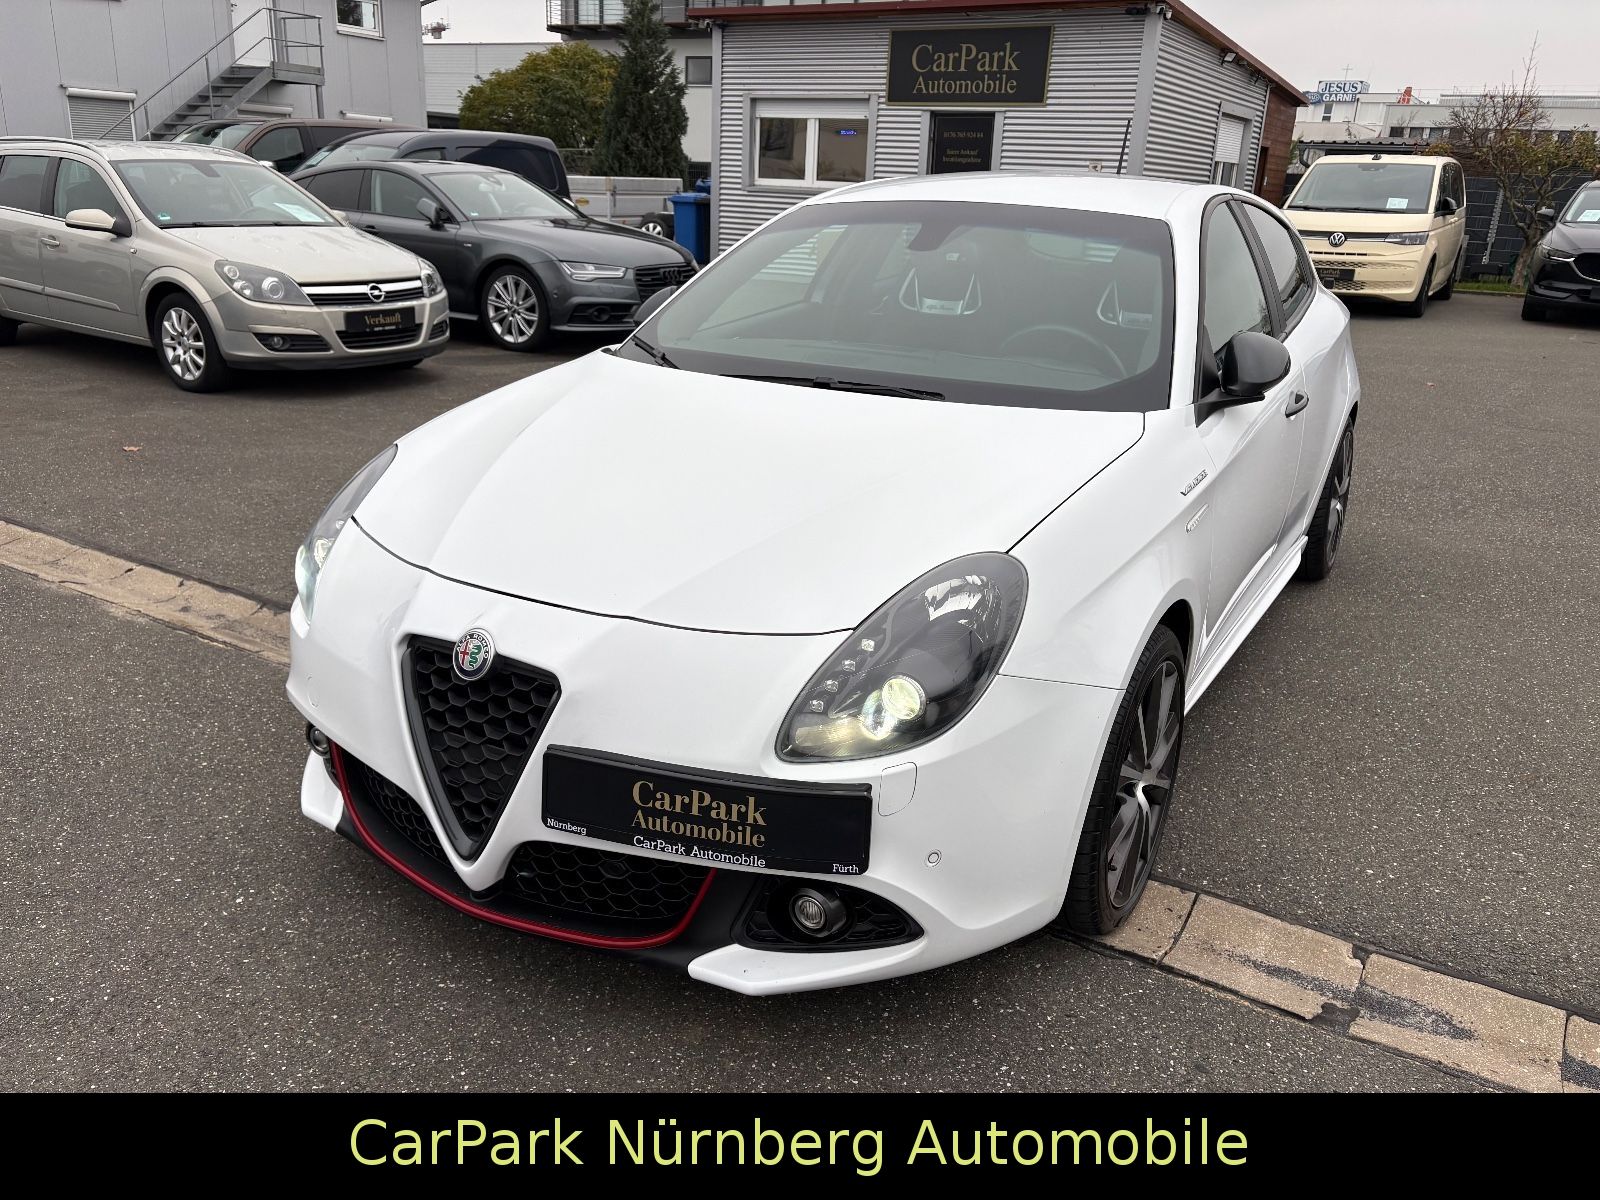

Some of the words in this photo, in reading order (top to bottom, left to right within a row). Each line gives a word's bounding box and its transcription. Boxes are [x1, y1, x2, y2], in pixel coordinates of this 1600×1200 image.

[912, 42, 1021, 73] CarPark
[912, 74, 1017, 94] Automobile
[1321, 82, 1359, 93] JESUS
[1322, 93, 1353, 102] GARNI
[473, 633, 489, 659] ROMEO
[632, 781, 767, 826] CarPark
[547, 817, 587, 835] Nürnberg
[632, 809, 765, 847] Automobile
[633, 835, 686, 856] CarPark
[690, 846, 766, 868] Automobile
[832, 863, 859, 874] Fürth
